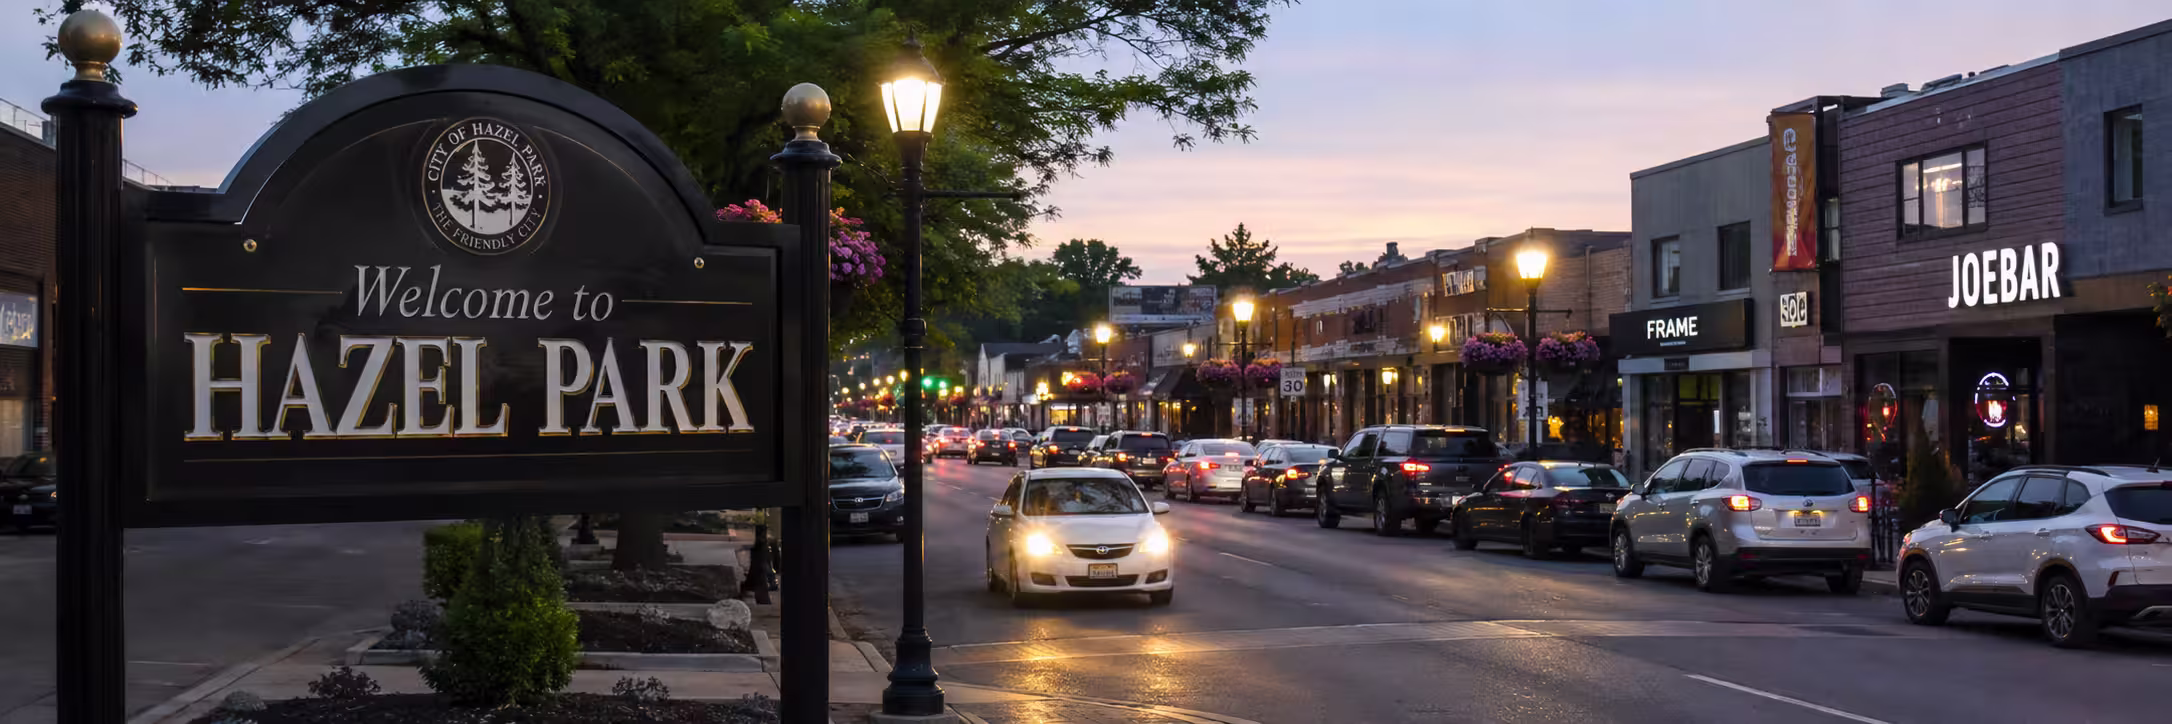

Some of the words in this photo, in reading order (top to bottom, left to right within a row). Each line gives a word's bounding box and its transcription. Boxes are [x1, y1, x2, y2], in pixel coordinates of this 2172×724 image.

[427, 143, 448, 181] CITY
[448, 126, 467, 145] OF
[472, 122, 519, 147] HAZEL
[521, 144, 546, 187] PARK
[433, 202, 453, 230] THE
[452, 228, 515, 250] FRIENDLY
[518, 207, 541, 237] CITY
[354, 264, 554, 320] Welcome
[572, 285, 614, 321] to
[1948, 242, 2060, 309] JOEBAR
[1647, 316, 1698, 340] FRAME
[184, 332, 510, 441] HAZEL
[537, 336, 754, 436] PARK
[1283, 380, 1303, 392] 30
